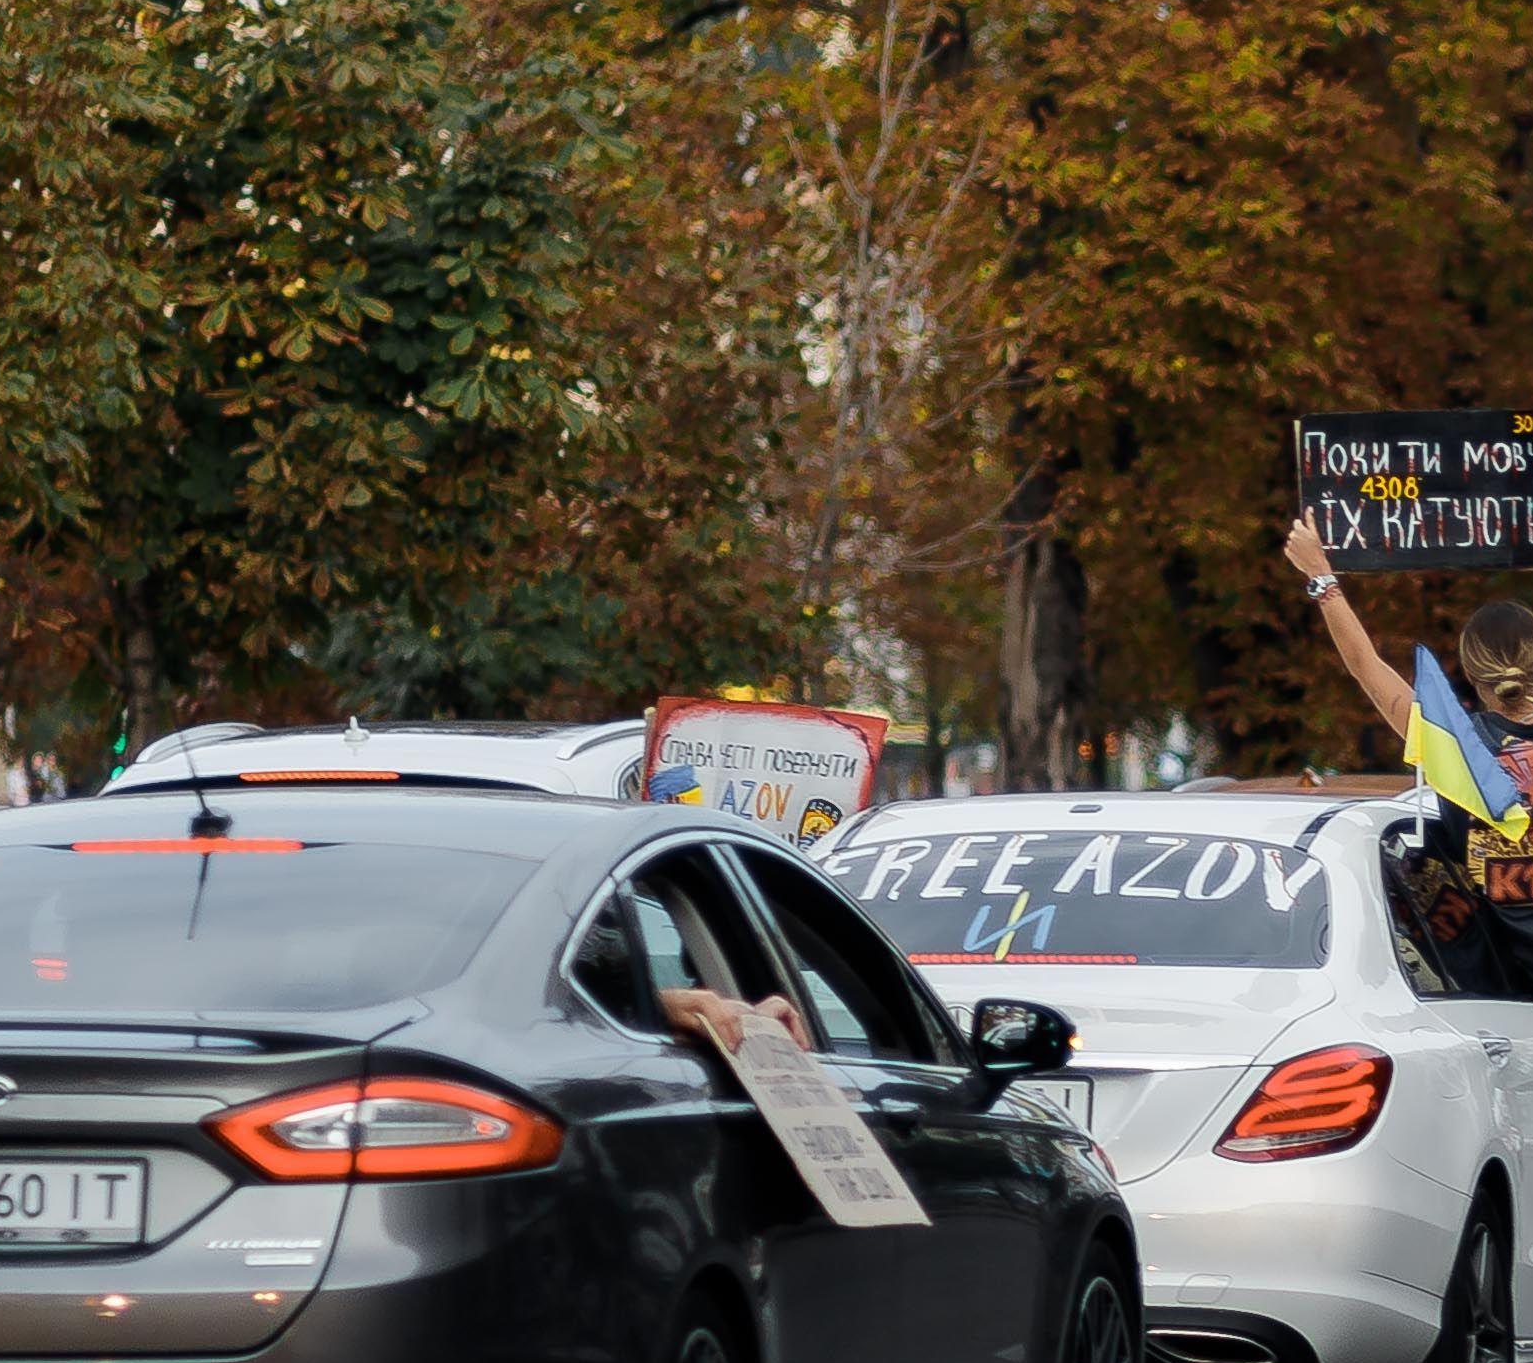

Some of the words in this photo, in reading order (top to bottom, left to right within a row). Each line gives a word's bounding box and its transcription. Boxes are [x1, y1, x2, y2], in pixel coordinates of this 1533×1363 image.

[1360, 475, 1420, 500] 4308
[1320, 490, 1368, 550] ЇХ
[718, 779, 793, 822] AZOV
[822, 833, 1051, 902] FREE
[1052, 833, 1323, 913] AZOV
[71, 1173, 128, 1220] IT
